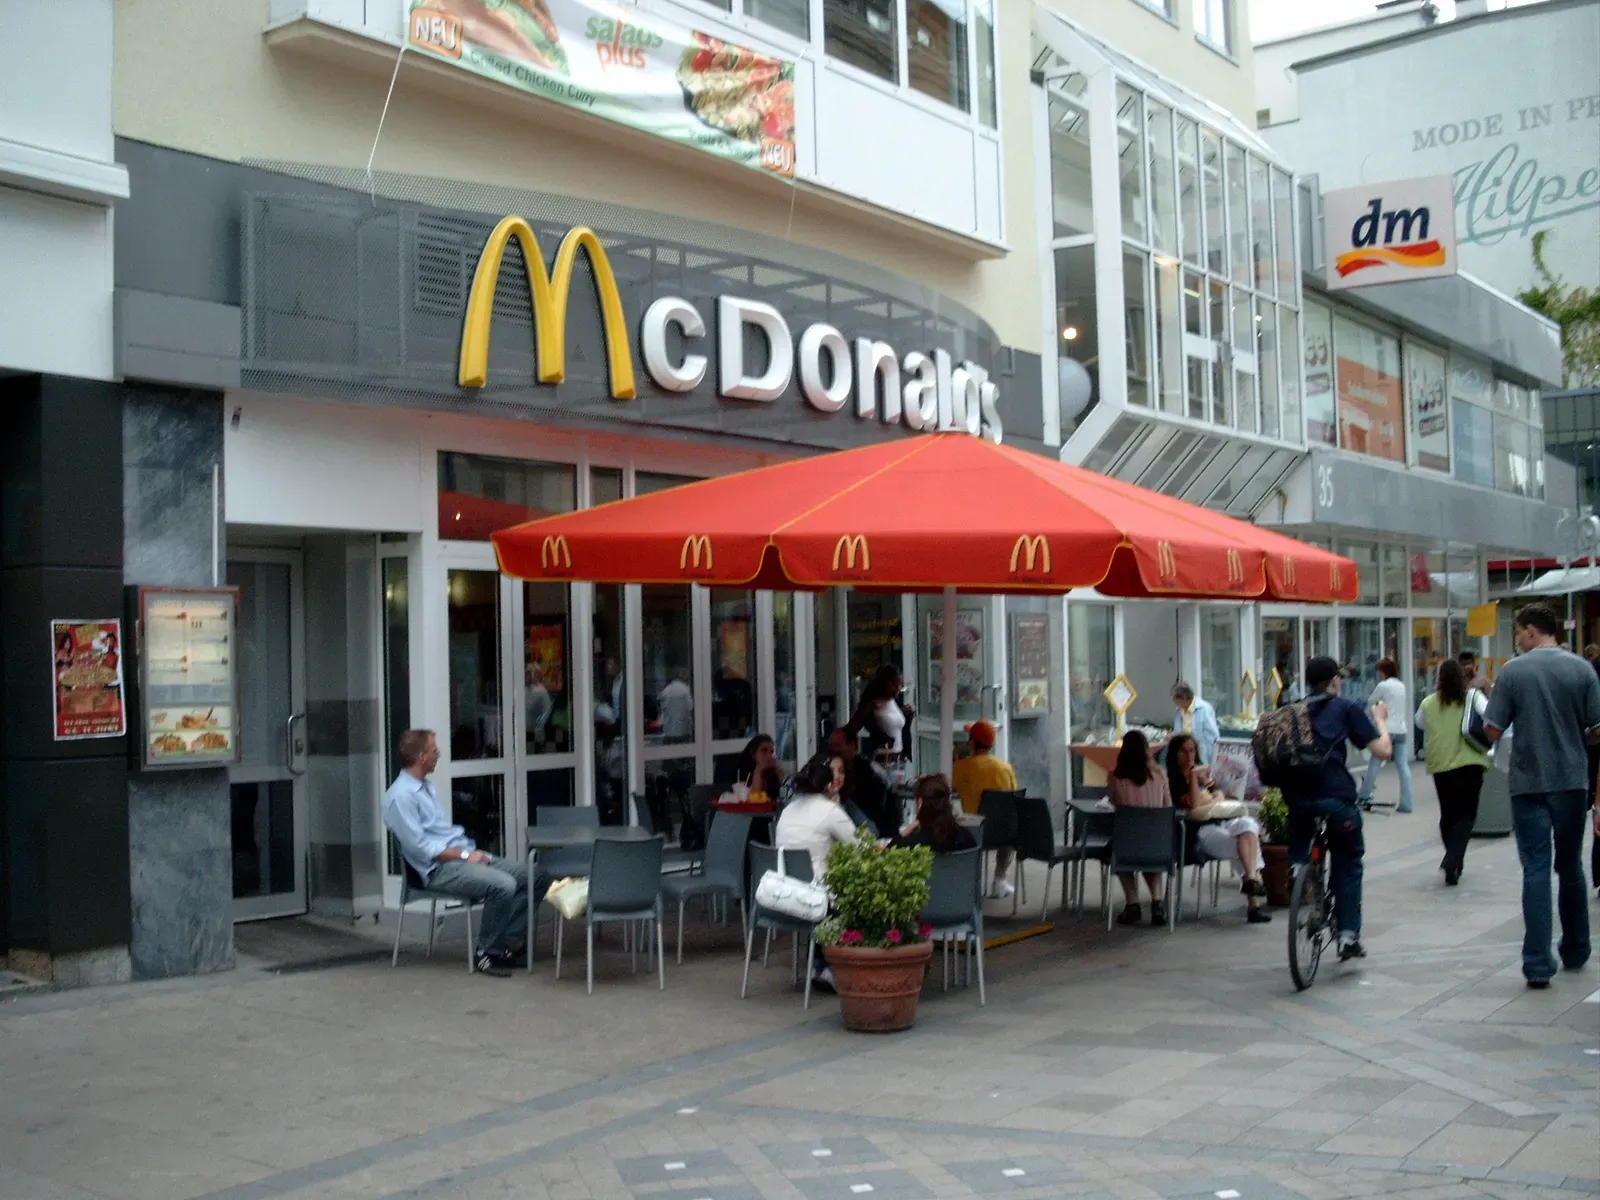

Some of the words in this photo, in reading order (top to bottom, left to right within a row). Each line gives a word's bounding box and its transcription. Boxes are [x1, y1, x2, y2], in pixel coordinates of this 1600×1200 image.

[415, 15, 457, 50] NEU
[595, 40, 646, 72] plus
[515, 66, 564, 95] Chicken
[567, 84, 597, 108] Curry
[1412, 113, 1503, 151] MODE
[1518, 104, 1552, 132] IN
[764, 143, 792, 172] NEU
[1352, 197, 1430, 248] dm
[1317, 464, 1334, 509] 35
